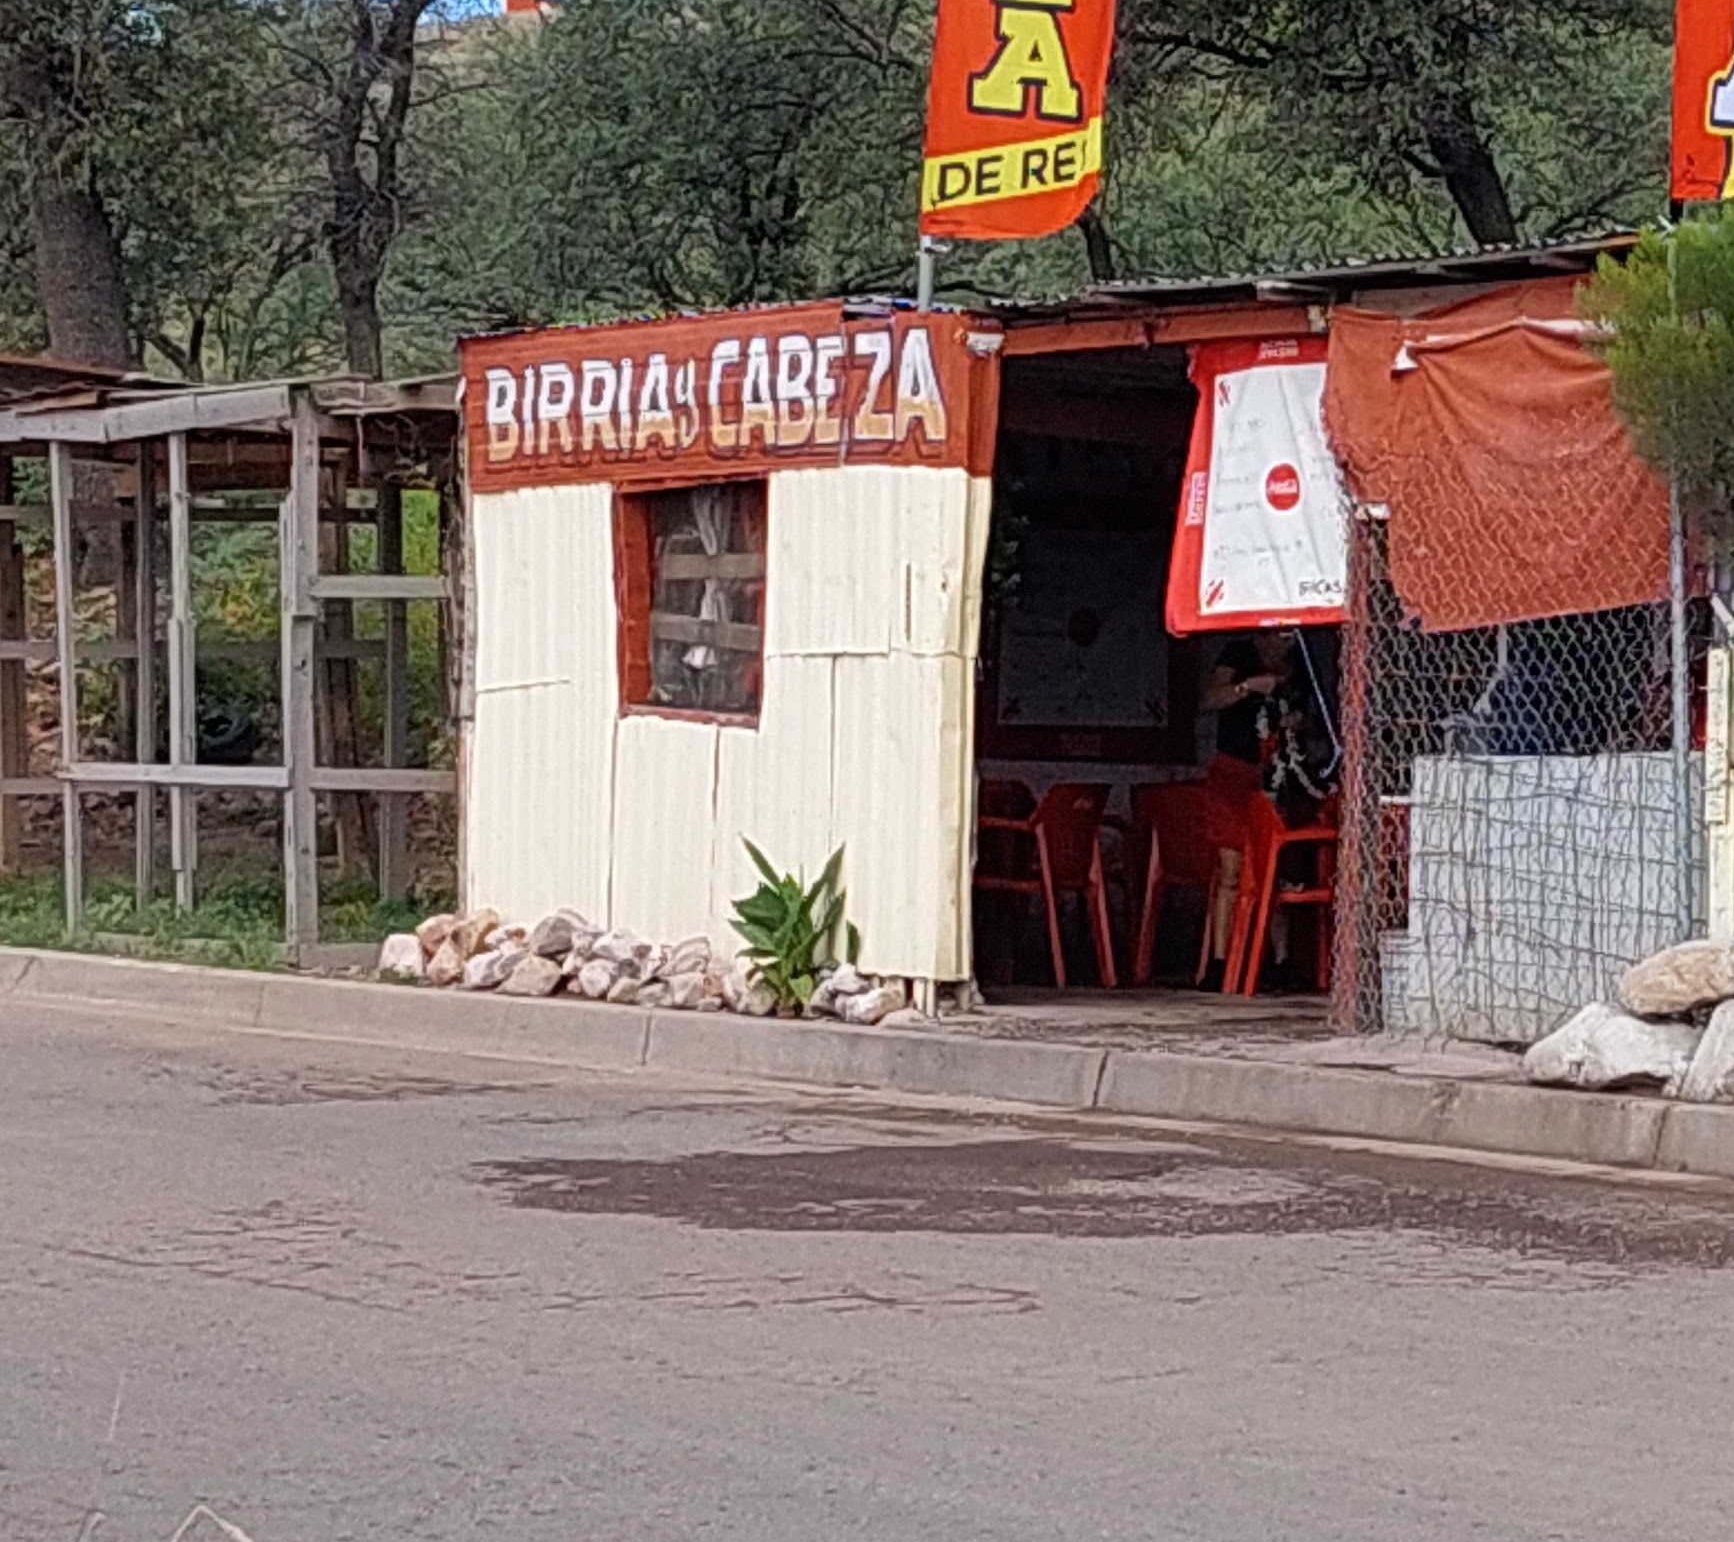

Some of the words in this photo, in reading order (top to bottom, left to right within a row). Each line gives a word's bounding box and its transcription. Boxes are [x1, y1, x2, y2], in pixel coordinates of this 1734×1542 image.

[938, 155, 1003, 201] DE
[1021, 141, 1086, 189] RE
[485, 353, 677, 463] BIRRIA
[708, 326, 948, 447] CABEZA
